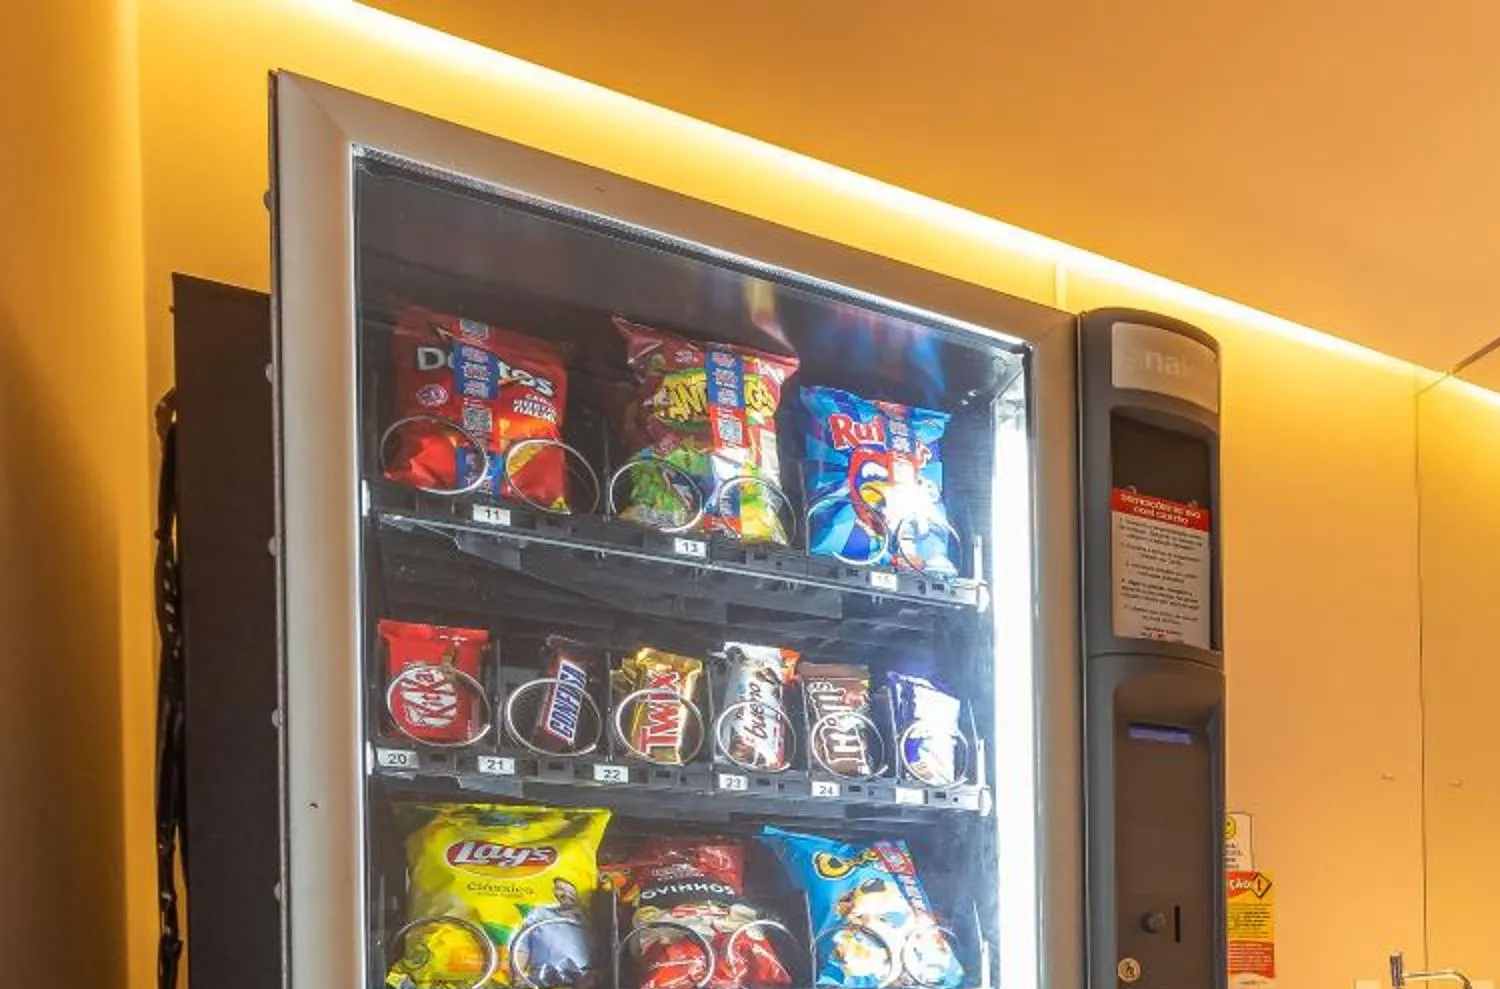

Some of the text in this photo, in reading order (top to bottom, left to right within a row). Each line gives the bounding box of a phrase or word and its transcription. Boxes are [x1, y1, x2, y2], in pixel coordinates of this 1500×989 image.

[388, 753, 407, 765] 20
[487, 759, 504, 770] 21
[603, 768, 620, 780] 22
